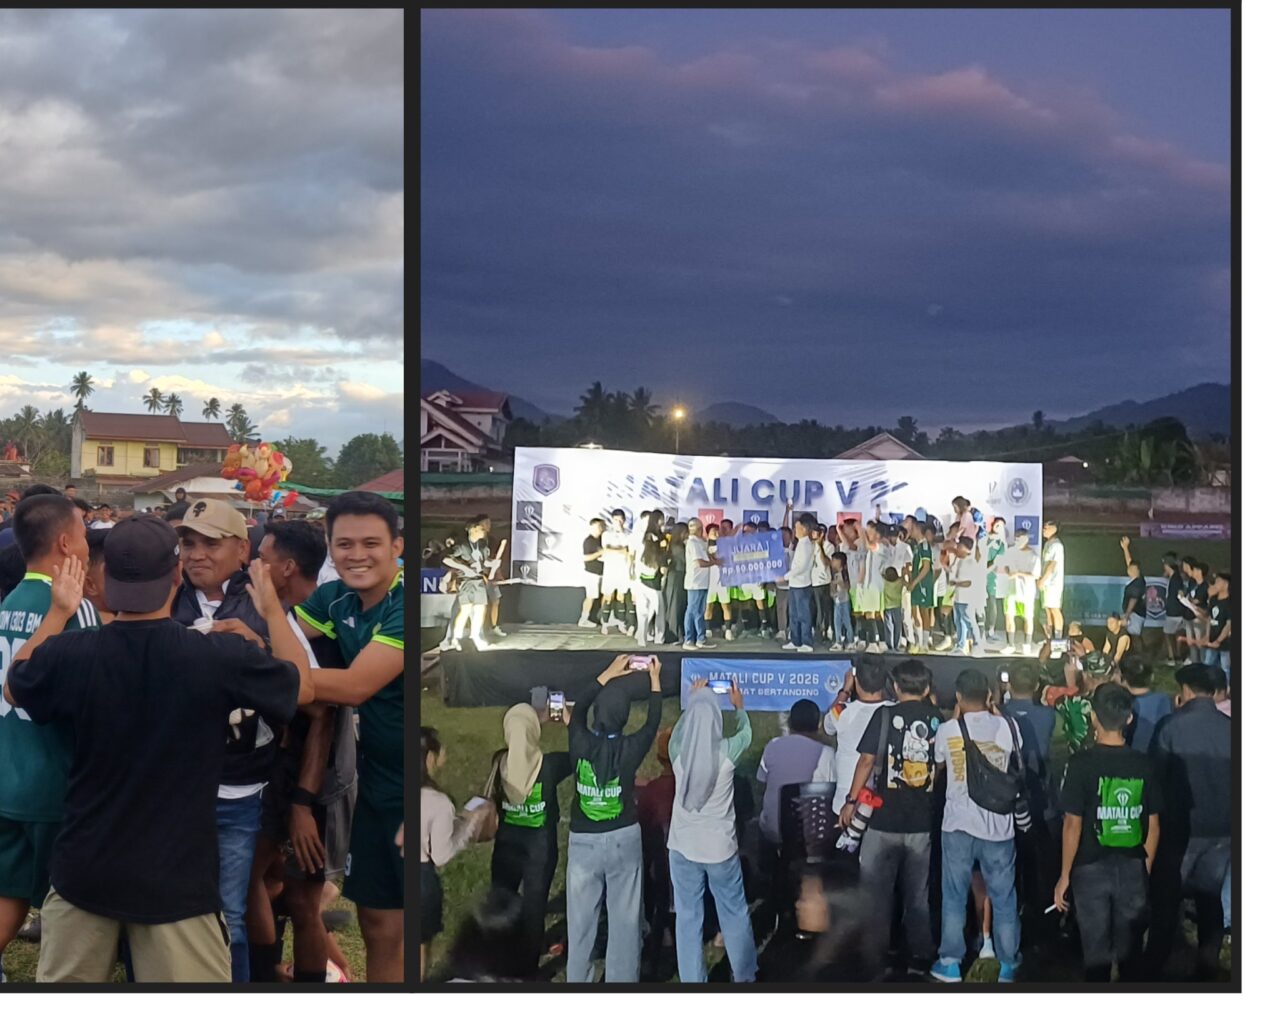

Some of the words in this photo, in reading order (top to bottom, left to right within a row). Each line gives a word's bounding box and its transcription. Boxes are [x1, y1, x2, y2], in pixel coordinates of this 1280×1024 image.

[751, 479, 824, 506] CUP
[835, 480, 860, 505] V
[751, 673, 774, 685] CUP
[777, 673, 786, 685] V
[789, 673, 819, 685] 2026
[605, 786, 622, 798] CUP
[529, 801, 546, 813] CUP
[1097, 806, 1129, 820] MATALI
